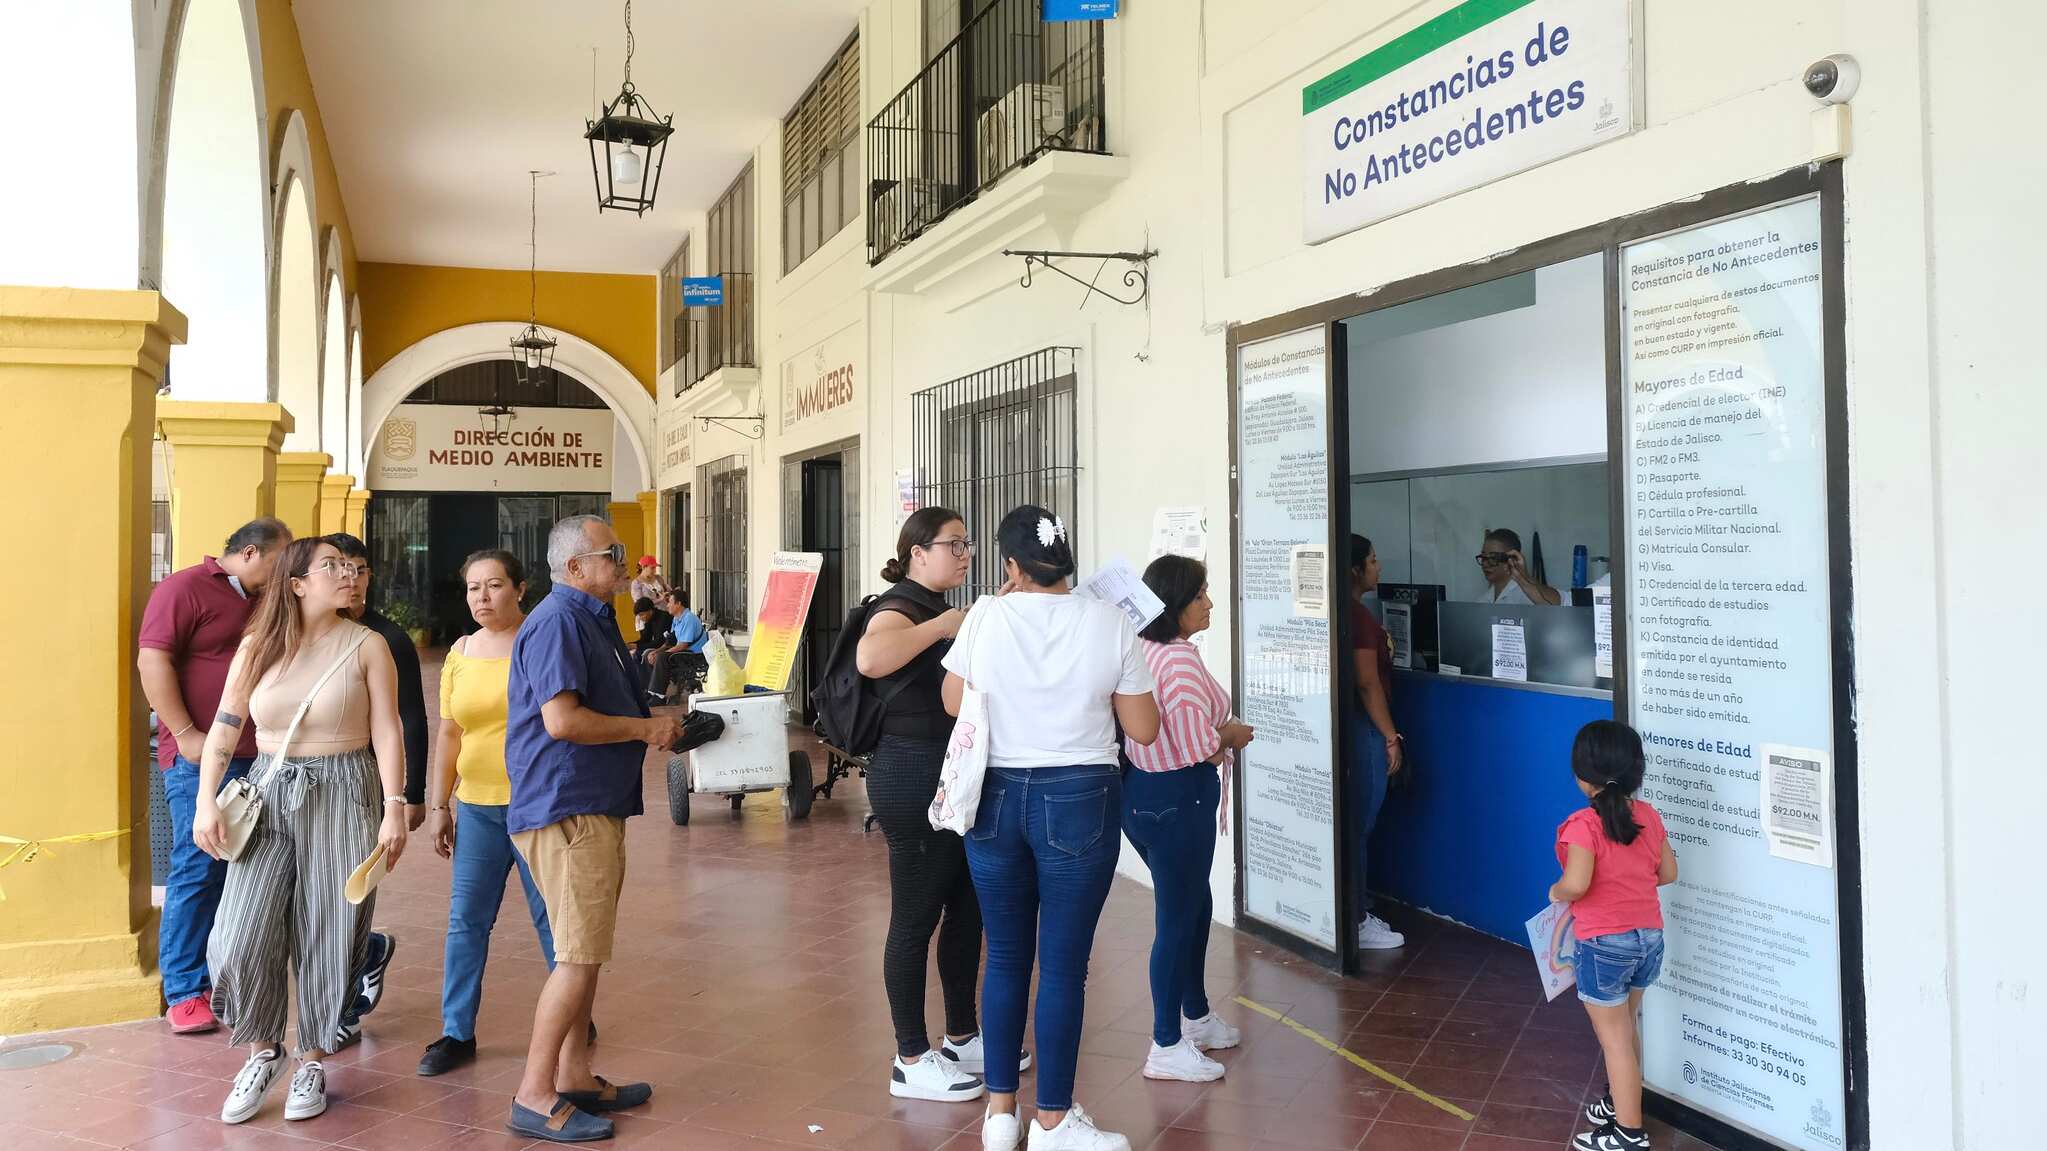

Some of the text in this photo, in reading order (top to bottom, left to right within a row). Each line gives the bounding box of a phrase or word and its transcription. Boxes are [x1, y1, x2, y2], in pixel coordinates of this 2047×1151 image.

[1333, 22, 1570, 151] Constancias de
[1593, 117, 1620, 132] Jalisco
[1324, 78, 1585, 205] No Antecedentes
[1632, 231, 1779, 275] Requisitos para obtener la
[1632, 241, 1818, 291] Constancia de No Antecedentes
[683, 287, 721, 297] infinitum
[1634, 273, 1819, 317] Presentar cualquiera de estos documentos
[1635, 352, 1646, 360] Así
[1648, 349, 1669, 359] como
[1671, 343, 1694, 355] CURP
[1708, 334, 1750, 350] impresión
[1753, 328, 1784, 340] oficial.
[1245, 346, 1324, 369] Módulos de Constancias
[1245, 365, 1309, 385] de No Antecedentes
[1635, 366, 1744, 395] Mayores de Edad
[796, 363, 854, 421] IMMUERES
[1636, 386, 1786, 415] A) Credencial de elector (INE)
[1647, 419, 1686, 431] Licencia
[1689, 415, 1701, 425] de
[1704, 413, 1742, 424] manejo
[1745, 409, 1761, 420] del
[454, 426, 582, 448] DIRECCIÓN DE
[1636, 433, 1722, 449] Estado de Jalisco.
[430, 450, 602, 468] MEDIO AMBIENTE
[1637, 457, 1647, 467] C)
[1649, 454, 1668, 465] FM2
[1679, 452, 1700, 463] FM3.
[1637, 471, 1701, 484] D) Pasaporte.
[1638, 486, 1746, 502] E) Cédula profesional.
[1638, 509, 1646, 519] F)
[1649, 507, 1686, 519] Cartilla
[1697, 505, 1757, 516] Pre-cartilla
[1638, 523, 1781, 536] del Servicio Militar Nacional.
[1639, 545, 1649, 554] G)
[1701, 543, 1751, 553] Consular.
[1639, 561, 1674, 571] H) Visa.
[1648, 579, 1701, 590] Credencial
[1704, 580, 1716, 590] de
[1719, 580, 1729, 590] la
[1732, 582, 1772, 592] tercera
[1775, 581, 1807, 592] edad.
[1640, 597, 1768, 610] J) Certificado de estudios
[1659, 615, 1712, 628] fotografía.
[1641, 632, 1779, 650] K) Constancia de identidad
[1641, 651, 1787, 670] emitida por el ayuntamiento
[1643, 731, 1751, 758] Menores de Edad
[1656, 755, 1711, 774] Certificado
[1714, 764, 1727, 775] de
[1729, 767, 1761, 781] estudi
[1779, 758, 1801, 768] AVISO
[1662, 775, 1715, 793] fotografía.
[1643, 788, 1761, 819] B) Credencial de estudi
[1772, 804, 1820, 822] $92.00 M.N.
[1698, 815, 1710, 827] de
[1713, 821, 1761, 839] conducir.
[1669, 970, 1817, 1026] Al momento de realizar el trámite
[1679, 986, 1734, 1013] proporcionar
[1736, 1007, 1747, 1017] un
[1749, 1010, 1779, 1028] correo
[1781, 1019, 1838, 1049] electrónico.
[1682, 1014, 1804, 1067] Forma de pago: Efectivo
[1683, 1031, 1806, 1086] Informes: 33 30 30 94 05
[1701, 1068, 1730, 1085] Instituto
[1732, 1080, 1771, 1102] Jalisciense
[1701, 1076, 1710, 1086] de
[1711, 1079, 1740, 1098] Ciencias
[1742, 1092, 1774, 1112] Forenses
[1803, 1121, 1841, 1146] Jalisco
